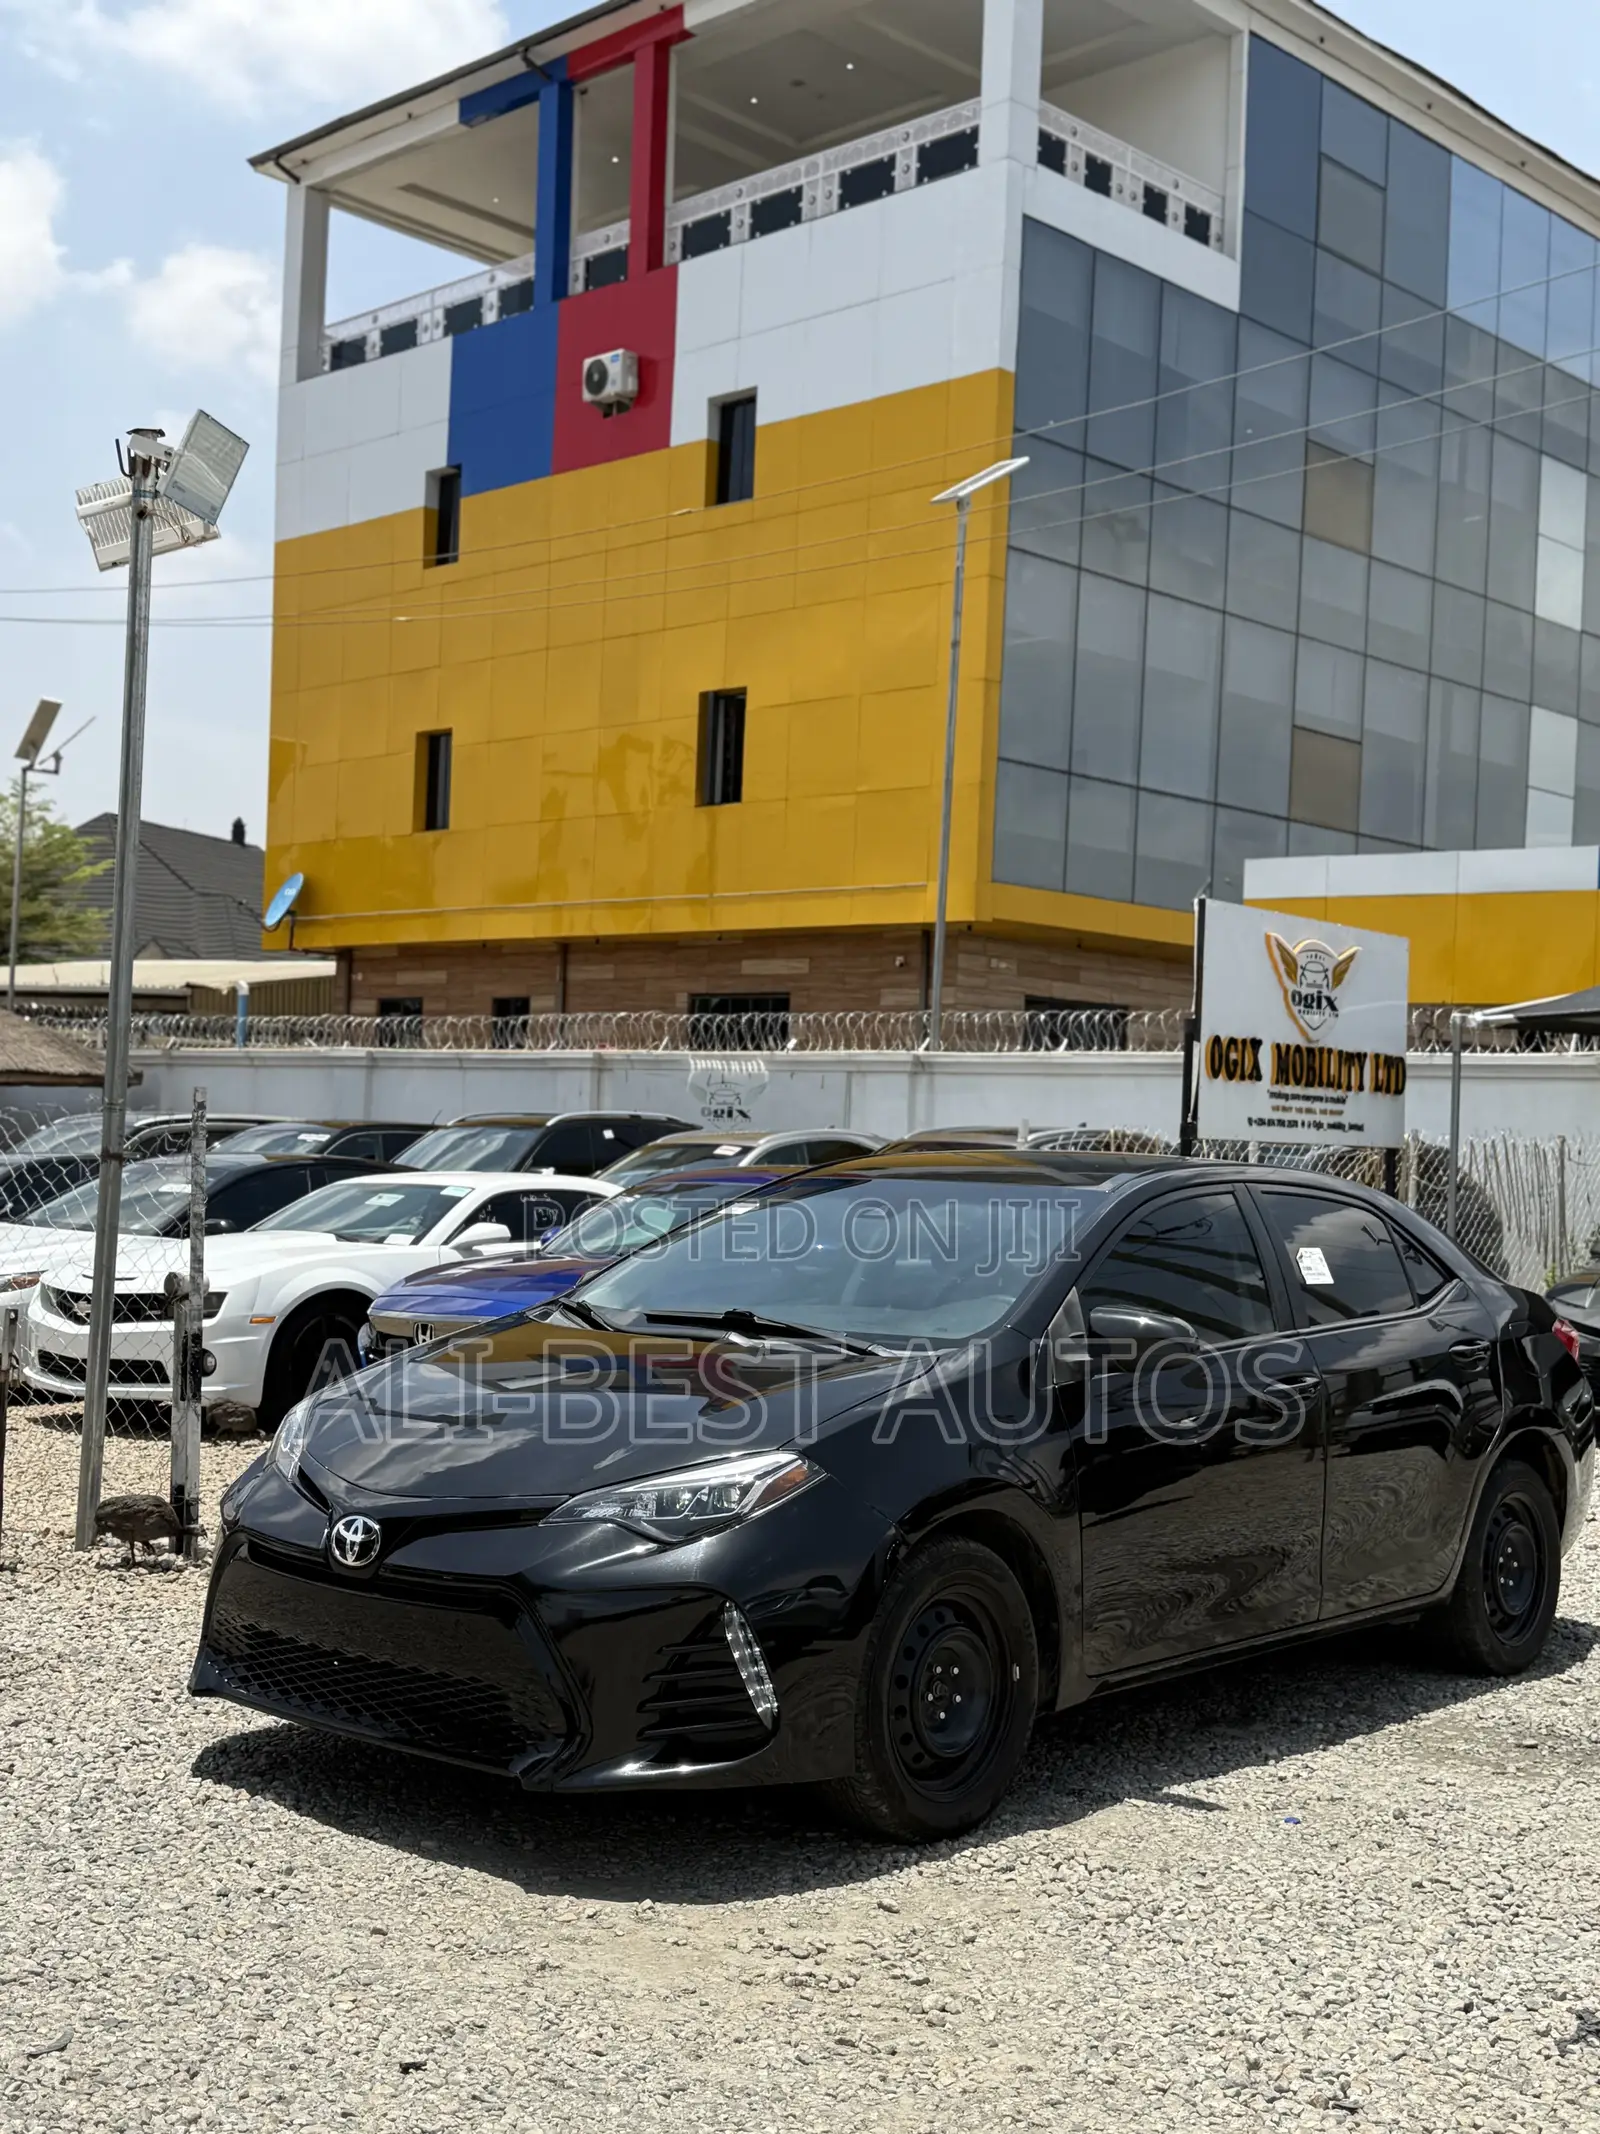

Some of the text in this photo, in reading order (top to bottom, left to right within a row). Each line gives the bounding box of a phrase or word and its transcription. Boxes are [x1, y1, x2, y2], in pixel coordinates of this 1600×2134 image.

[1206, 1035, 1406, 1095] OGIX MOBILITY LTD
